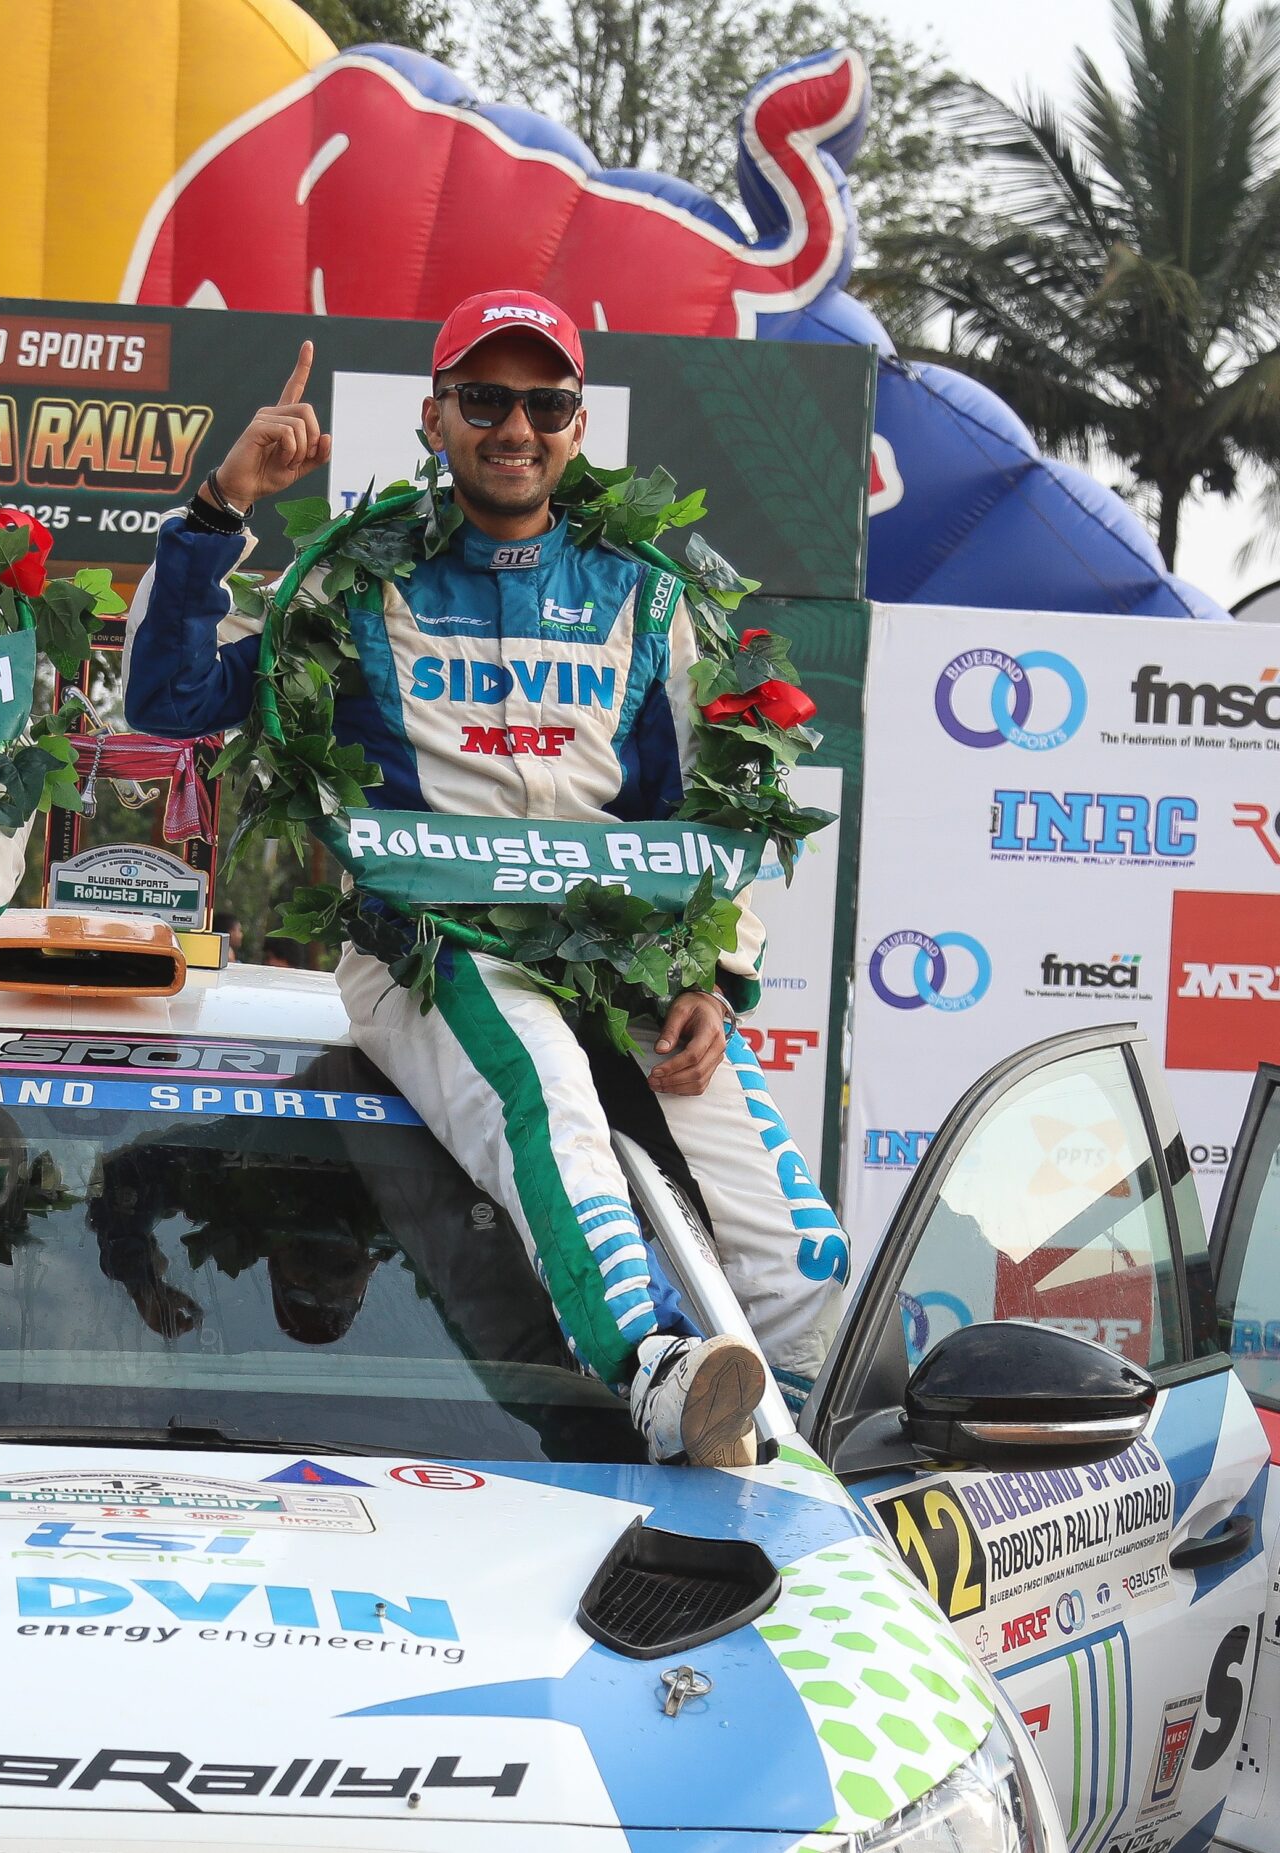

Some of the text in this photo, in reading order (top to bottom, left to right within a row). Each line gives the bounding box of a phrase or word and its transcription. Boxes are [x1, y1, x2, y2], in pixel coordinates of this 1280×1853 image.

[481, 306, 558, 328] MRF
[18, 331, 146, 373] SPORTS
[27, 400, 208, 480] RALLY
[99, 508, 161, 534] KOD
[541, 598, 595, 625] tsi
[649, 572, 677, 622] sparco
[541, 621, 597, 632] RACING
[945, 650, 1024, 683] BLUEBAND
[410, 656, 615, 710] SIDVIN
[460, 726, 576, 757] MRF
[1007, 727, 1068, 750] SPORTS
[1100, 732, 1262, 751] The Federation of Motor Sports
[991, 789, 1198, 857] INRC
[348, 816, 746, 892] Robusta Rally
[990, 853, 1025, 862] INDIAN
[1028, 855, 1080, 865] NATIONAL
[74, 885, 181, 907] Robusta Rally
[88, 876, 169, 888] BLUEBAND SPORTS
[877, 931, 940, 958] BLUEBAND
[761, 977, 808, 990] IMITED
[1041, 953, 1142, 988] fmsci
[1177, 962, 1280, 1001] MR
[927, 993, 976, 1013] SPORTS
[738, 1028, 821, 1071] RF
[149, 1083, 386, 1123] SPORTS
[1056, 1148, 1106, 1168] PPTS
[102, 1480, 164, 1492] 12
[413, 1469, 462, 1486] E
[10, 1492, 261, 1511] Robusta Rally
[40, 1487, 228, 1499] BLUEBAND SPORTS
[961, 1468, 1083, 1530] BLUEBAND
[25, 1522, 258, 1555] tsi
[988, 1481, 1170, 1582] ROBUSTA RALLY, KODAGU
[11, 1551, 267, 1568] RACING
[894, 1490, 982, 1618] 12
[990, 1530, 1169, 1605] BLUEBAND FMSCI INDIAN NATIONAL RALLY CHAMPIONSHIP 2025
[1122, 1564, 1168, 1599] ROBUSTA
[17, 1621, 467, 1665] energy engineering
[1001, 1606, 1051, 1653] MRF
[1166, 1729, 1188, 1745] KMSC
[1155, 1810, 1183, 1826] CHAMPION
